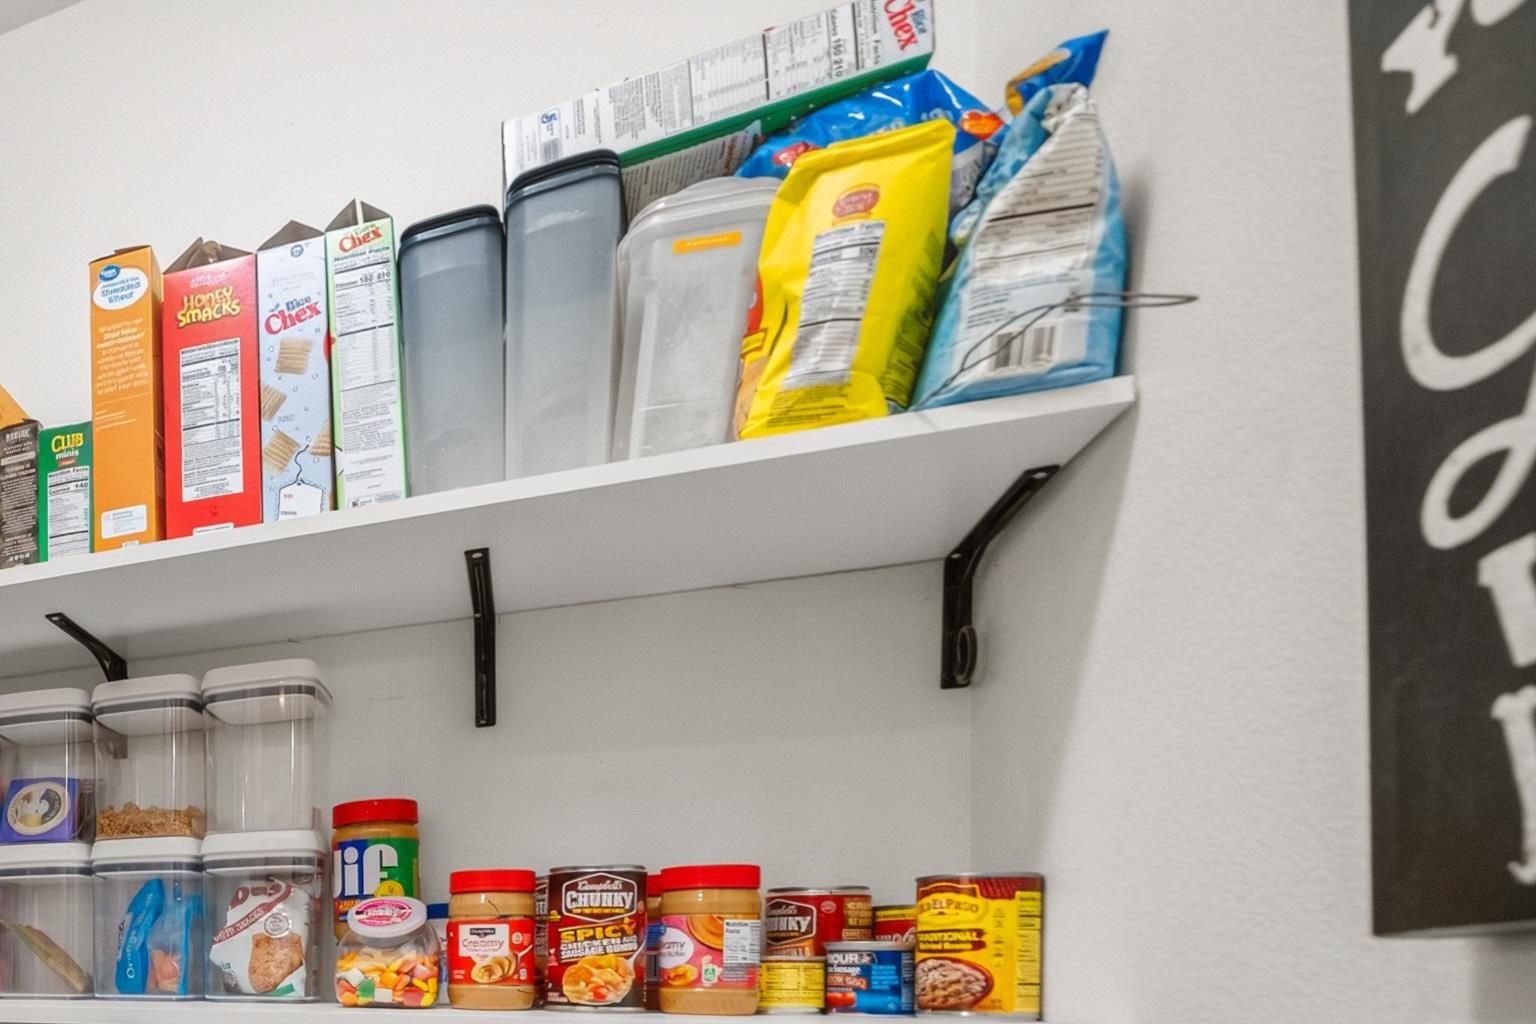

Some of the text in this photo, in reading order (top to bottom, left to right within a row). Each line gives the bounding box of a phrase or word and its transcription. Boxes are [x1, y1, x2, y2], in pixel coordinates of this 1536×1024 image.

[883, 0, 920, 50] Chex
[338, 226, 382, 252] Chex
[264, 300, 322, 335] Chex
[51, 432, 84, 453] CLUB
[332, 843, 399, 900] Jif
[577, 880, 623, 891] Campbell's
[565, 891, 634, 909] CHUNKY
[560, 923, 637, 943] SPICY
[462, 938, 504, 950] Creamy
[662, 941, 685, 950] amy
